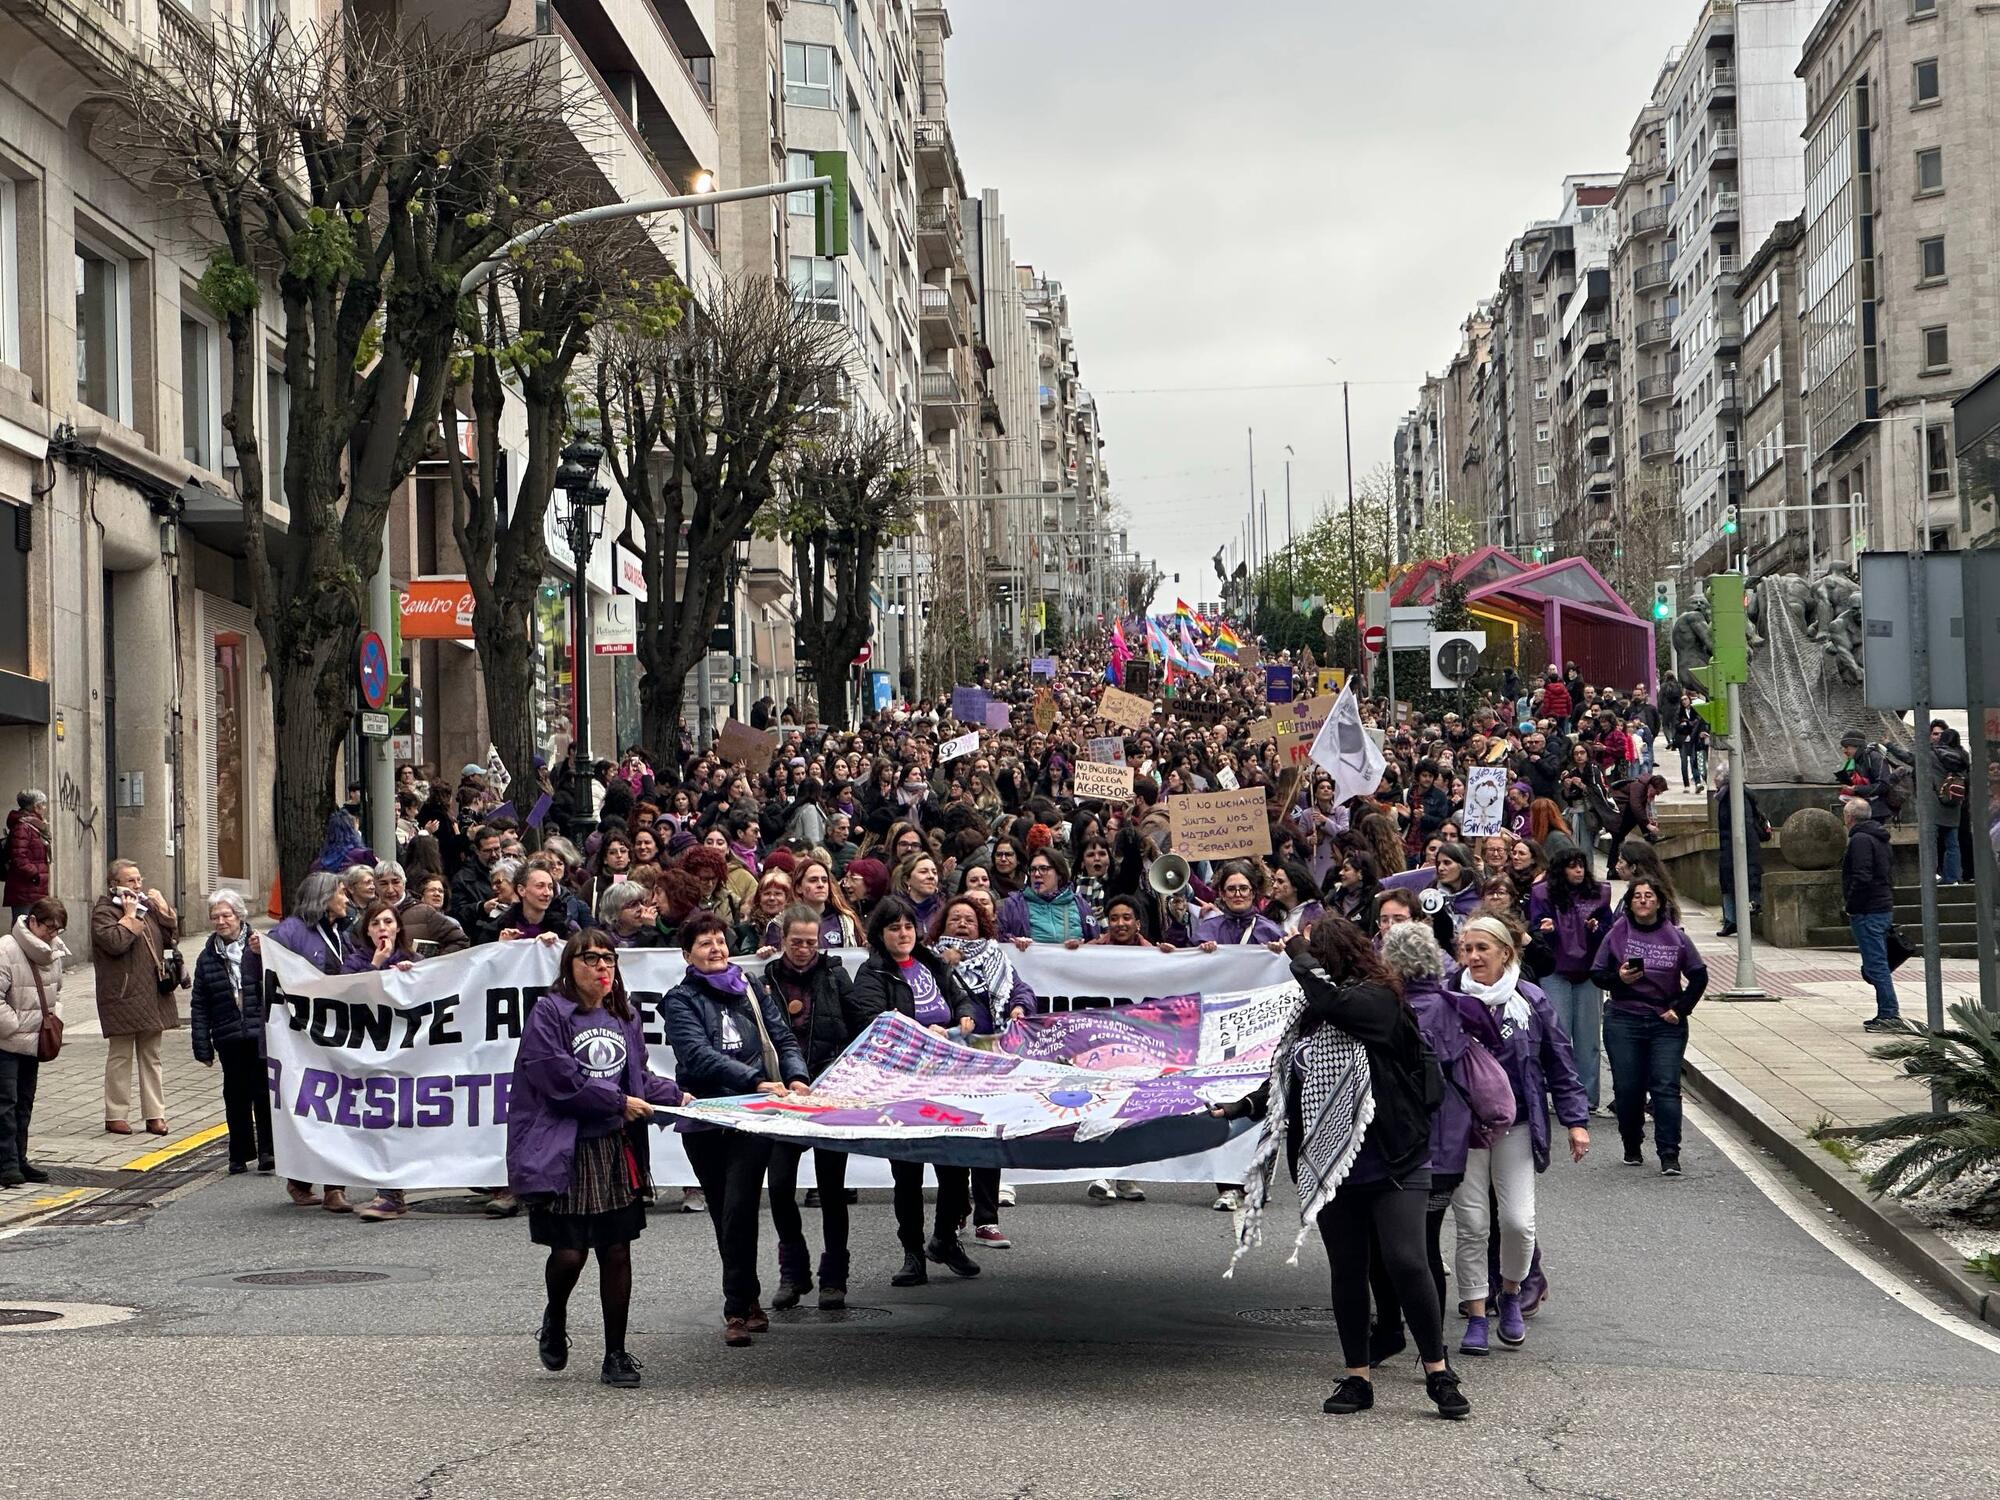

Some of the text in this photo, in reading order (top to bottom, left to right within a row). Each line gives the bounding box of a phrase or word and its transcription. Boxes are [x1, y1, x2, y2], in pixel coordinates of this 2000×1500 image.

[399, 592, 453, 616] Ramiro
[602, 645, 627, 653] pikolin
[1172, 699, 1226, 715] QUEREMO
[1276, 717, 1327, 735] ECOFEMINI
[1077, 763, 1087, 771] NO
[1092, 775, 1123, 784] COLEGA
[1077, 782, 1129, 797] AGRESOR
[1197, 801, 1211, 809] NO
[1215, 797, 1265, 809] LUCHAMOS
[1182, 814, 1248, 826] JUNTAS NOS
[1236, 825, 1254, 833] POR
[1197, 840, 1253, 852] SEPARADO
[265, 968, 463, 1052] FRONTE
[1220, 999, 1272, 1023] FRONTE
